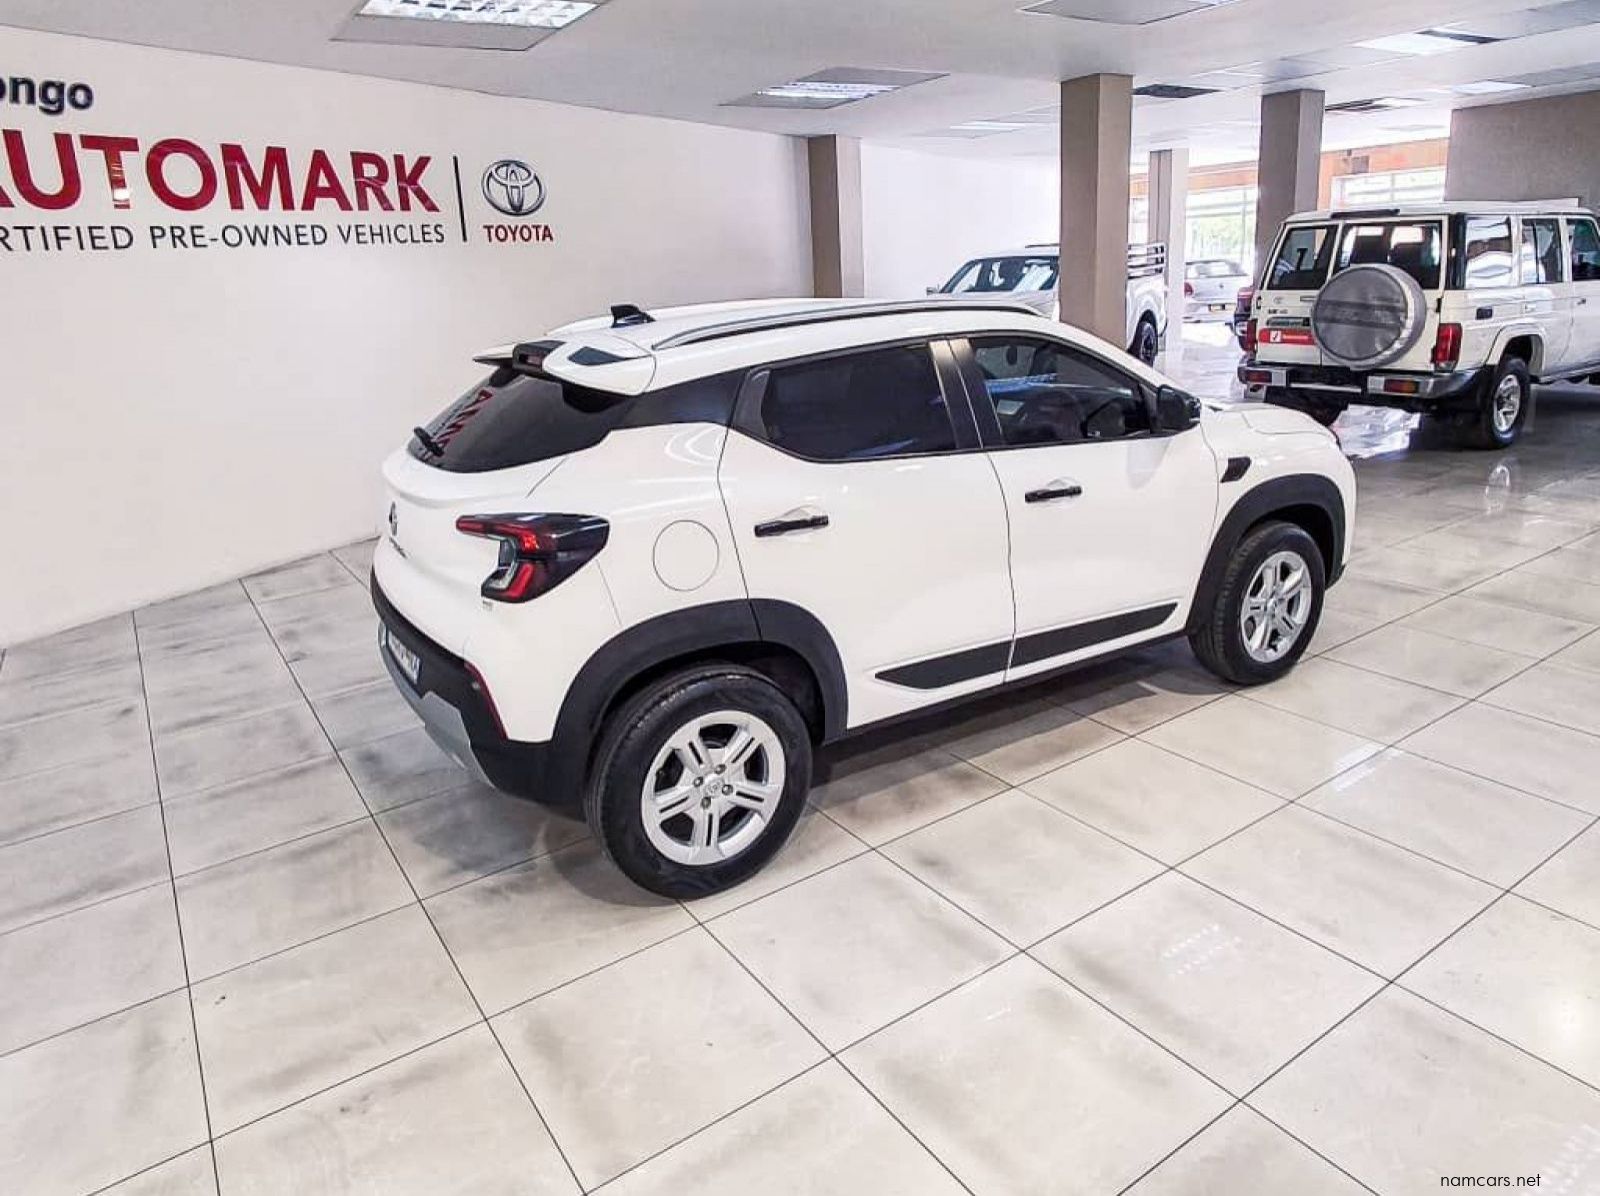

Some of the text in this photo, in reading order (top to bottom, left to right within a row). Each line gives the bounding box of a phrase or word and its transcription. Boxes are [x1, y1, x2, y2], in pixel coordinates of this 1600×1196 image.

[0, 76, 94, 115] ngo
[0, 129, 440, 212] UTOMARK
[149, 224, 328, 249] PRE-OWNED
[337, 223, 445, 245] VEHICLES
[482, 224, 554, 243] TOYOTA
